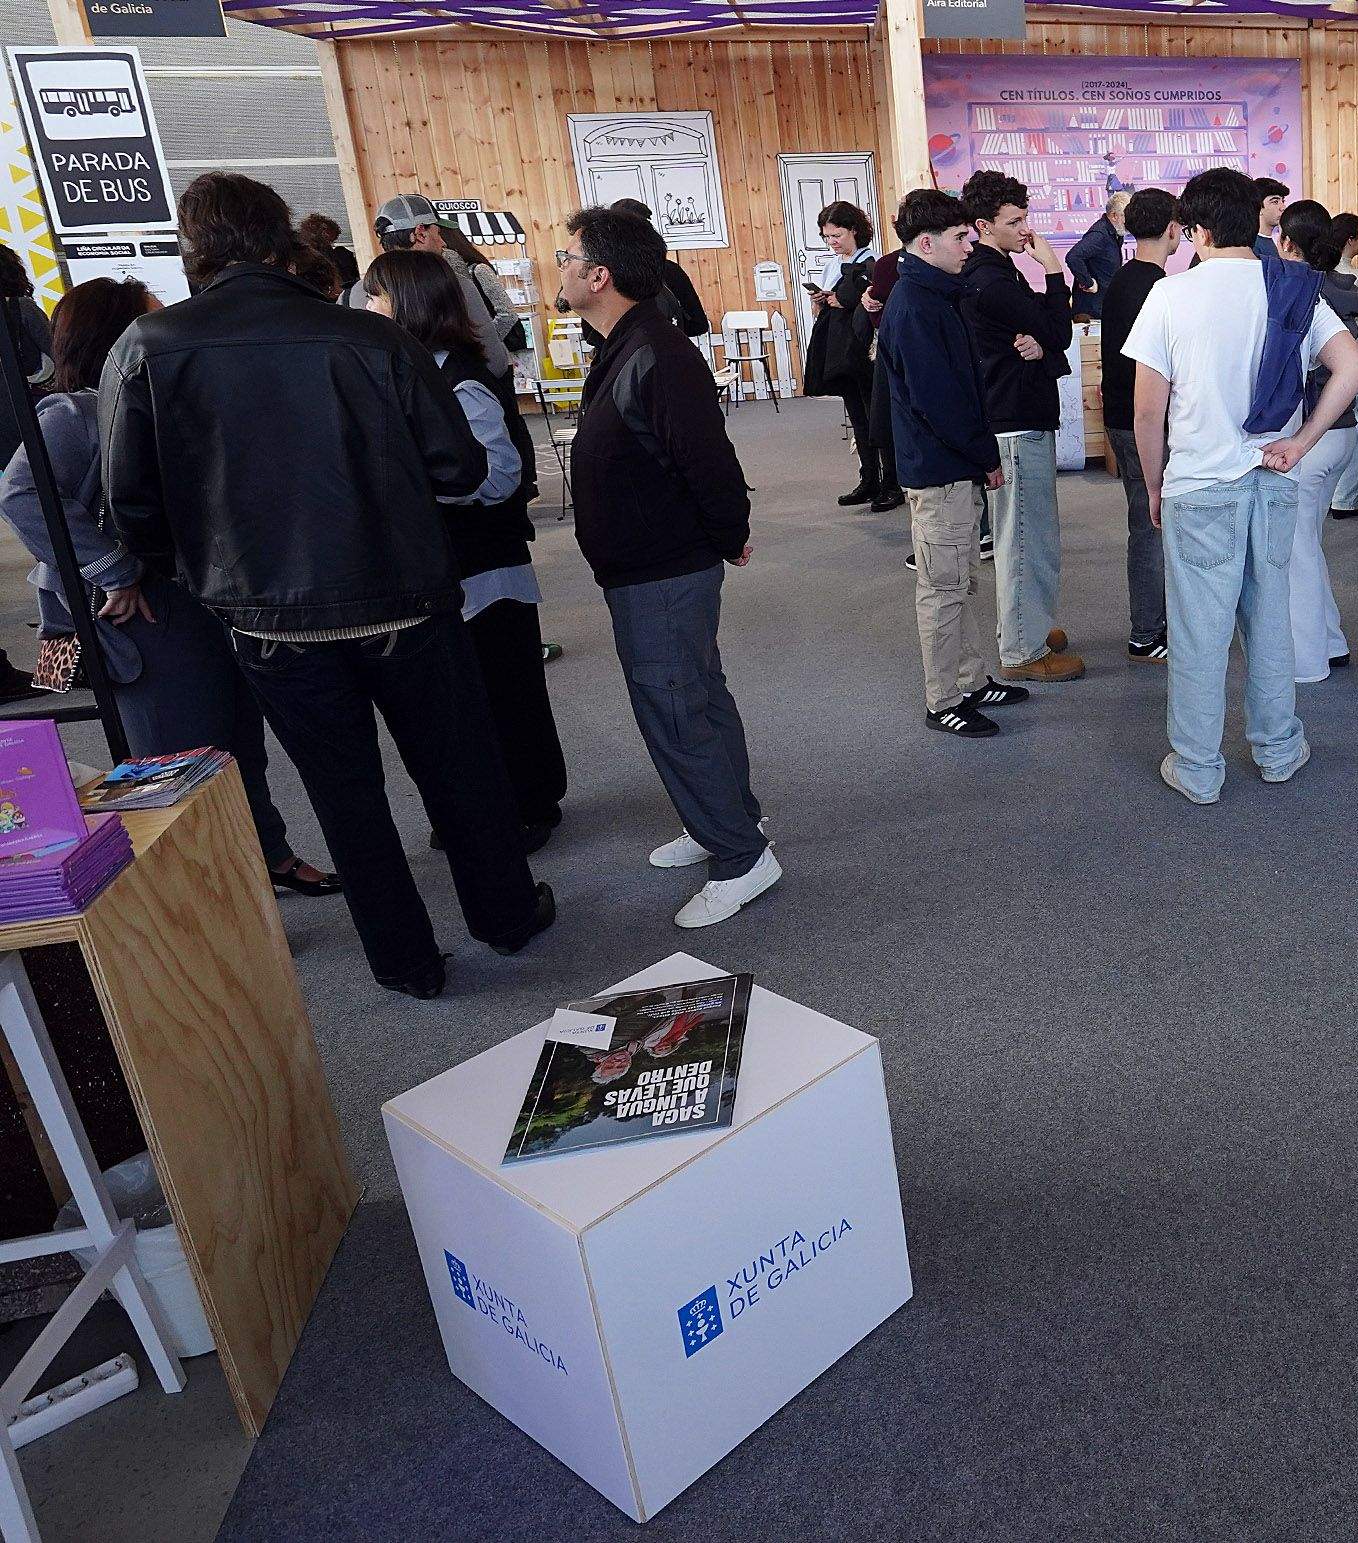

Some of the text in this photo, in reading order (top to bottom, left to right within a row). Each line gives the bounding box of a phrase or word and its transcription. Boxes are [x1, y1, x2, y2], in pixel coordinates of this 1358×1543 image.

[91, 3, 153, 14] de Galicia
[1000, 90, 1024, 101] CEN
[1082, 90, 1105, 101] CEN
[1109, 87, 1151, 101] SOÑOS
[1153, 90, 1222, 101] CUMPRIDOS
[51, 152, 151, 172] PARADA
[63, 177, 152, 203] DE BUS
[438, 202, 477, 210] QUIOSCO
[637, 1060, 713, 1086] DENTRO
[603, 1074, 710, 1106] QUE LEVAS
[616, 1088, 709, 1118] A LINGUA
[652, 1104, 706, 1127] SACA
[726, 1230, 806, 1298] XUNTA
[729, 1218, 853, 1320] DE GALICIA
[473, 1274, 528, 1329] XUNTA
[477, 1295, 568, 1376] DE GALICIA
